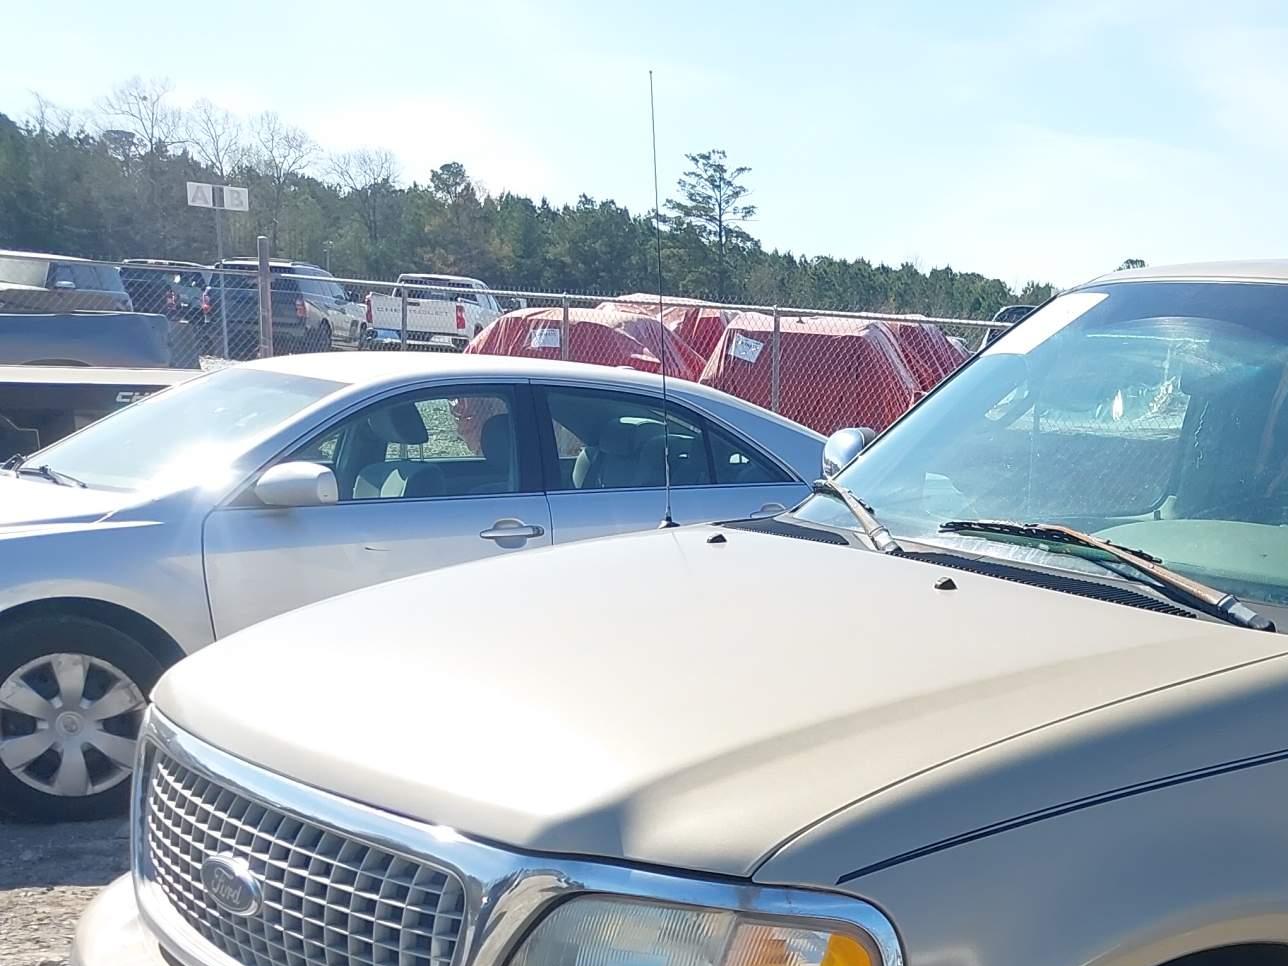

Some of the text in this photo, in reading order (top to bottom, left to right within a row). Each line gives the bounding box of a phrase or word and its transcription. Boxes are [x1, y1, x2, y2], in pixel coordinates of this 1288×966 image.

[191, 185, 244, 208] A B
[376, 306, 449, 316] CHEROLET
